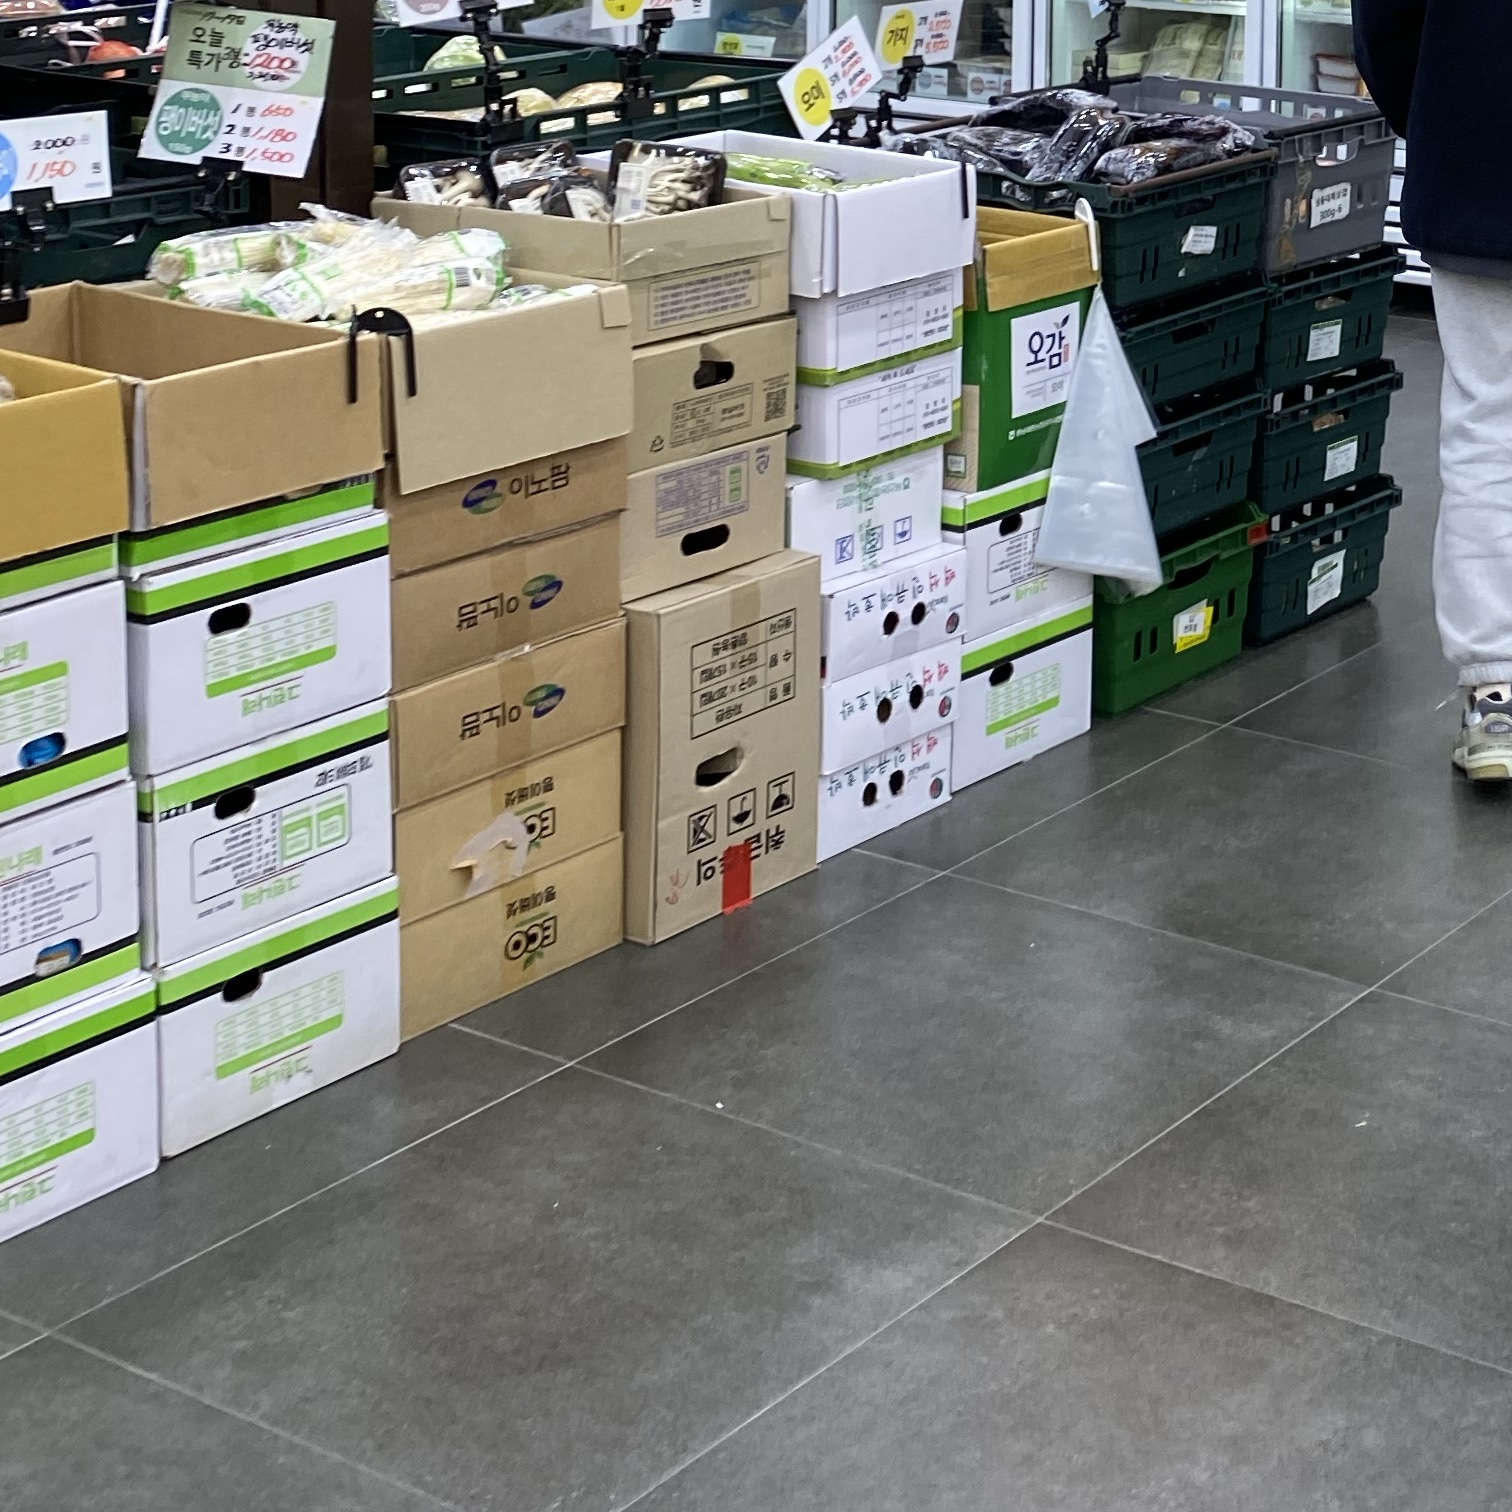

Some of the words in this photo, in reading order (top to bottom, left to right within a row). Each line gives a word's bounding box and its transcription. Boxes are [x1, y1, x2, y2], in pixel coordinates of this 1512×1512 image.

[188, 26, 225, 48] 오늘
[886, 25, 909, 47] 가지
[187, 50, 221, 72] 특가
[800, 79, 826, 112] 오이
[158, 104, 222, 140] 팽이버섯
[223, 123, 236, 136] 2
[218, 142, 232, 154] 3
[1026, 330, 1066, 370] 오감
[509, 462, 571, 500] 이노팜
[457, 592, 520, 633] 이노팜
[459, 701, 521, 743] 이노팜
[506, 886, 556, 920] 팽이버섯
[504, 915, 557, 962] ECO
